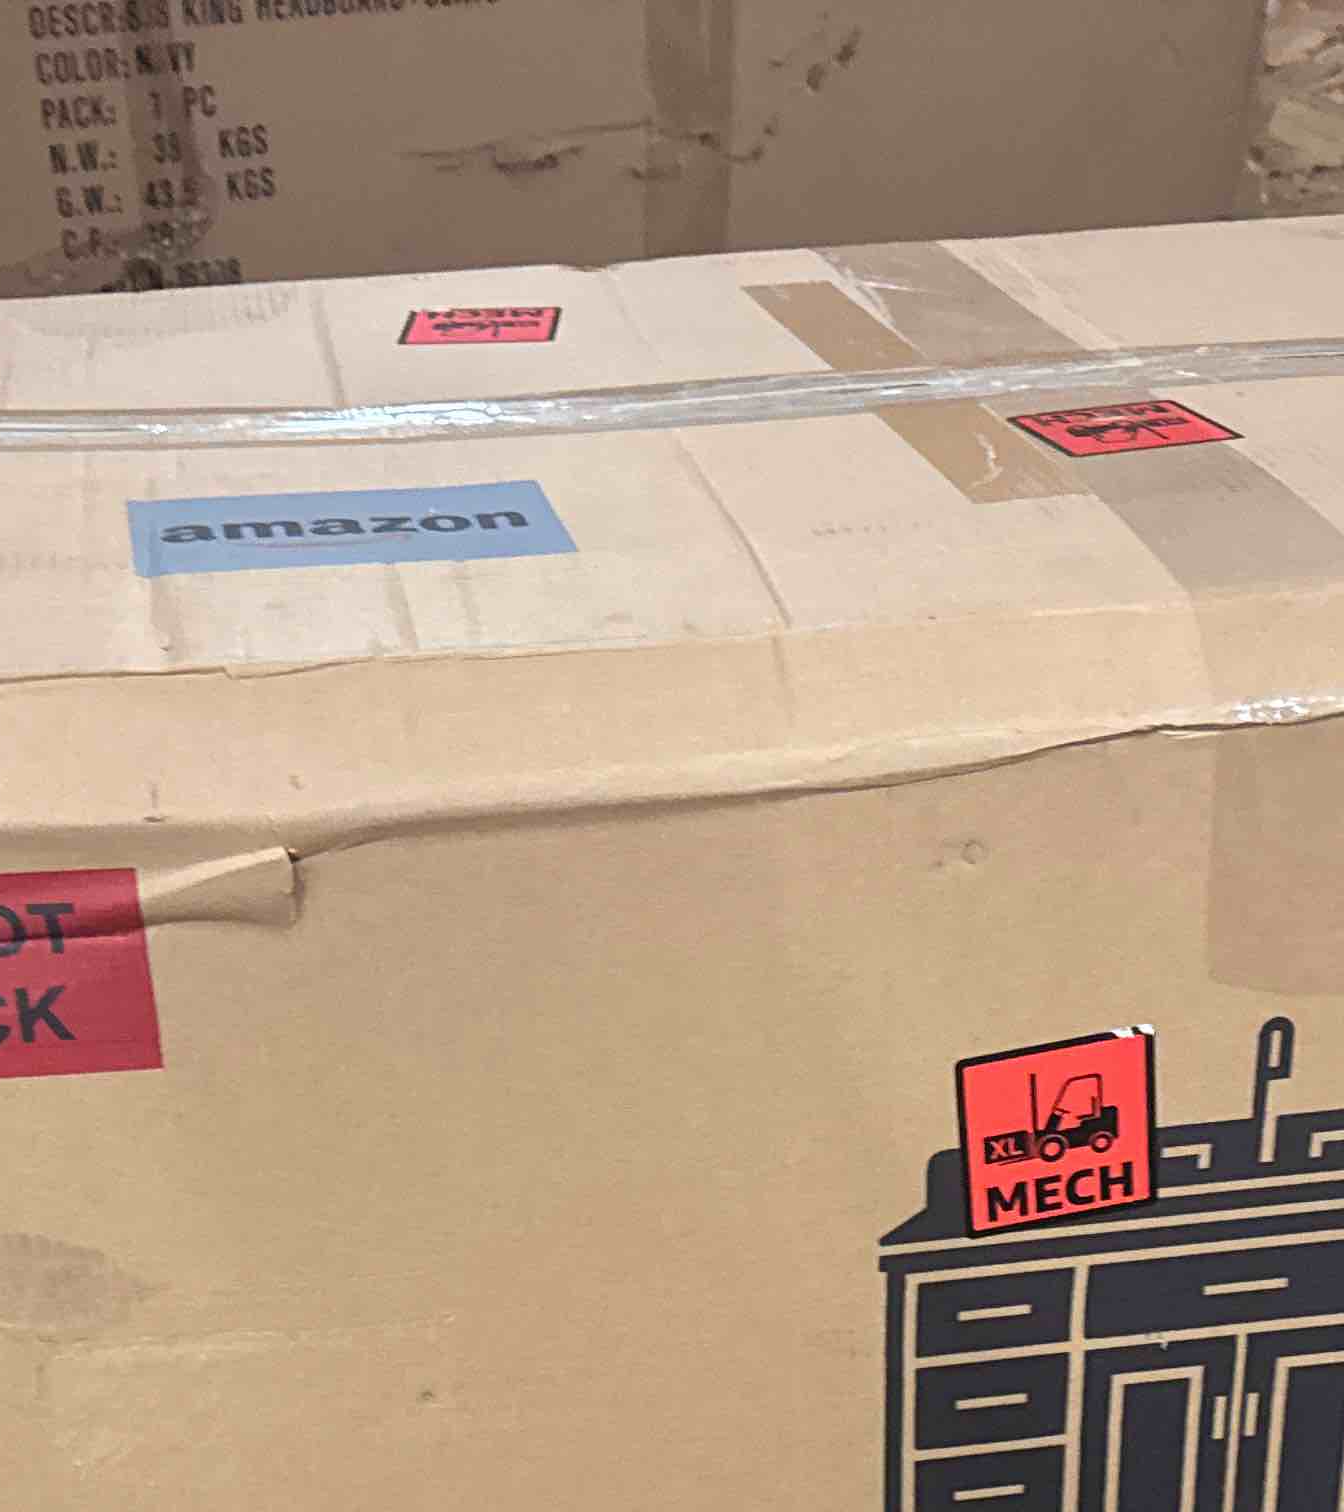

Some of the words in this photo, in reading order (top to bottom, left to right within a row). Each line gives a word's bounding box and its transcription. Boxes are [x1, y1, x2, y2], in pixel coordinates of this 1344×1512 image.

[40, 95, 117, 130] PACK:
[181, 84, 217, 119] PC
[218, 123, 269, 159] KGS
[225, 165, 276, 202] KGS
[159, 508, 530, 544] amazon
[989, 1135, 1025, 1161] XL
[986, 1161, 1135, 1222] MECH
